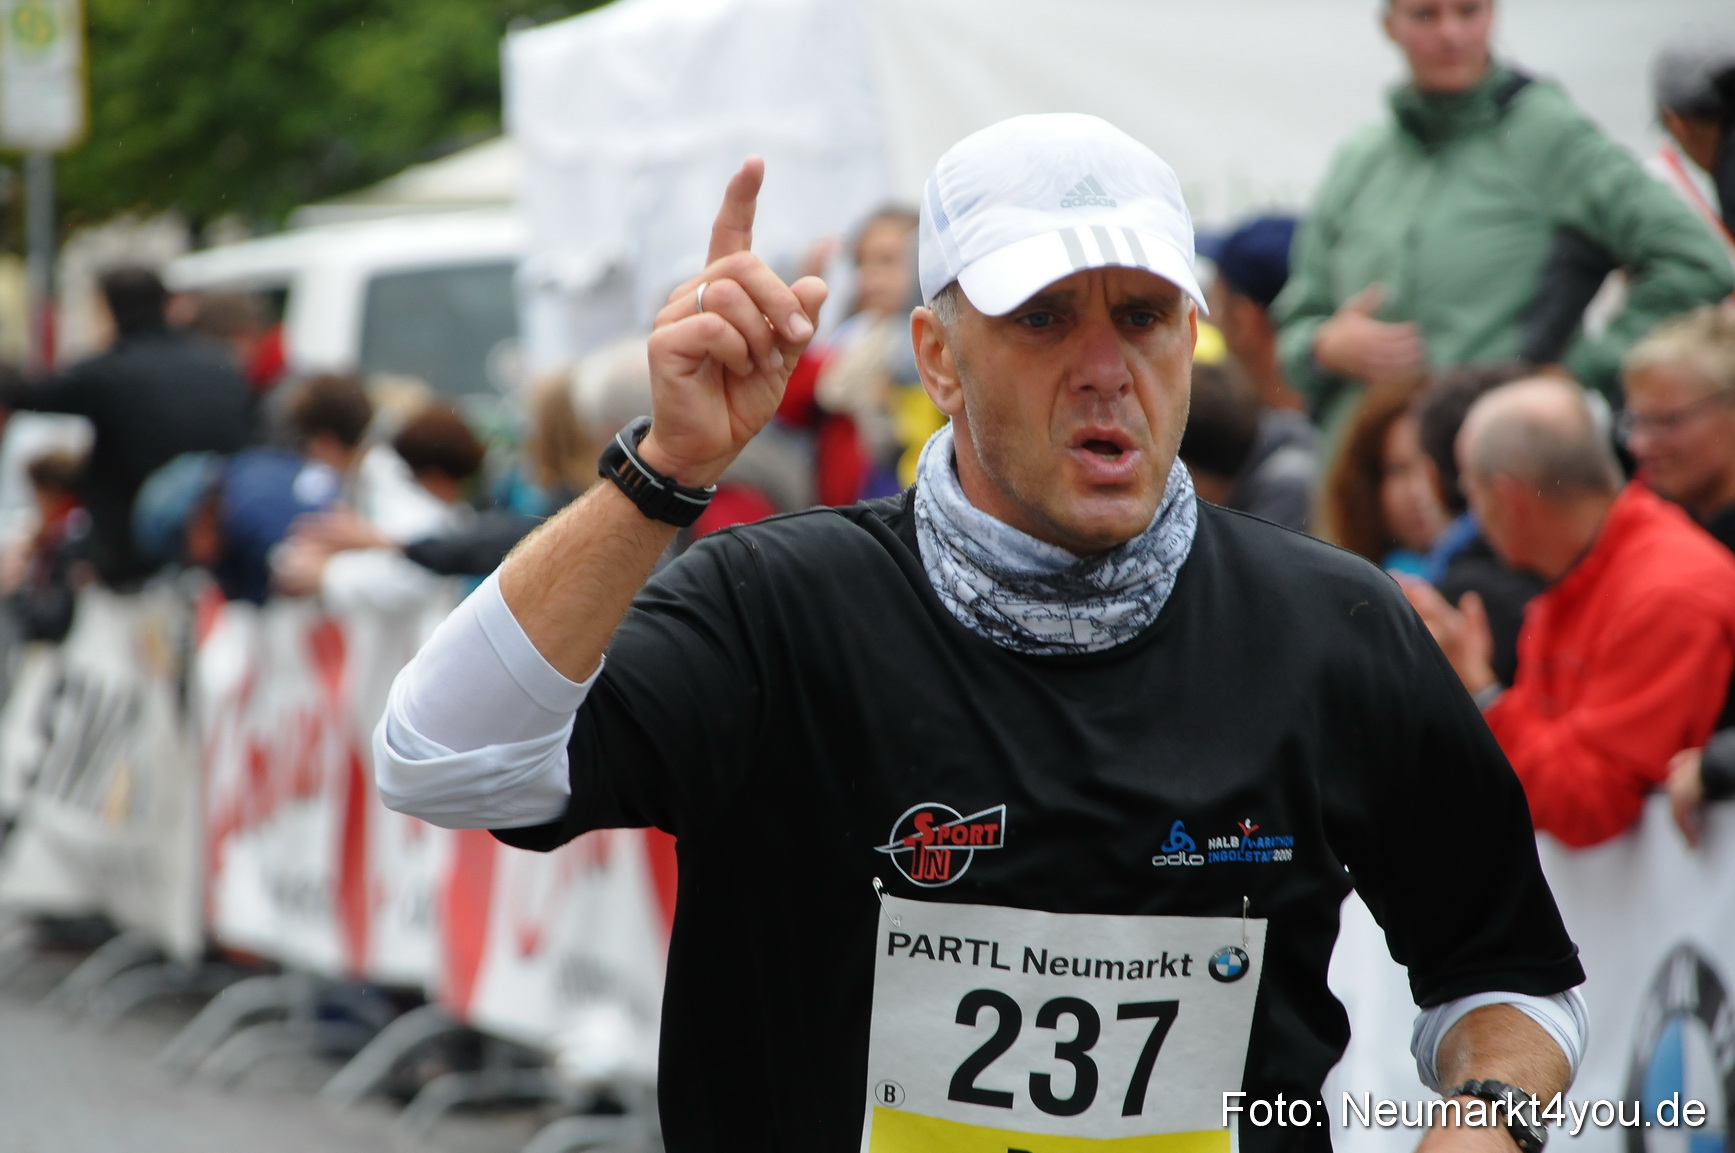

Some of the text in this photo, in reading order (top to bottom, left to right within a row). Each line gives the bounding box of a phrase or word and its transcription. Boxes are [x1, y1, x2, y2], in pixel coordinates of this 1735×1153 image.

[1060, 195, 1118, 208] adidas
[1208, 835, 1240, 850] HALB
[911, 841, 951, 880] IN
[1151, 850, 1205, 867] odlo
[887, 932, 1193, 980] PARTL Neumarkt
[947, 988, 1180, 1118] 237
[883, 1084, 896, 1103] B
